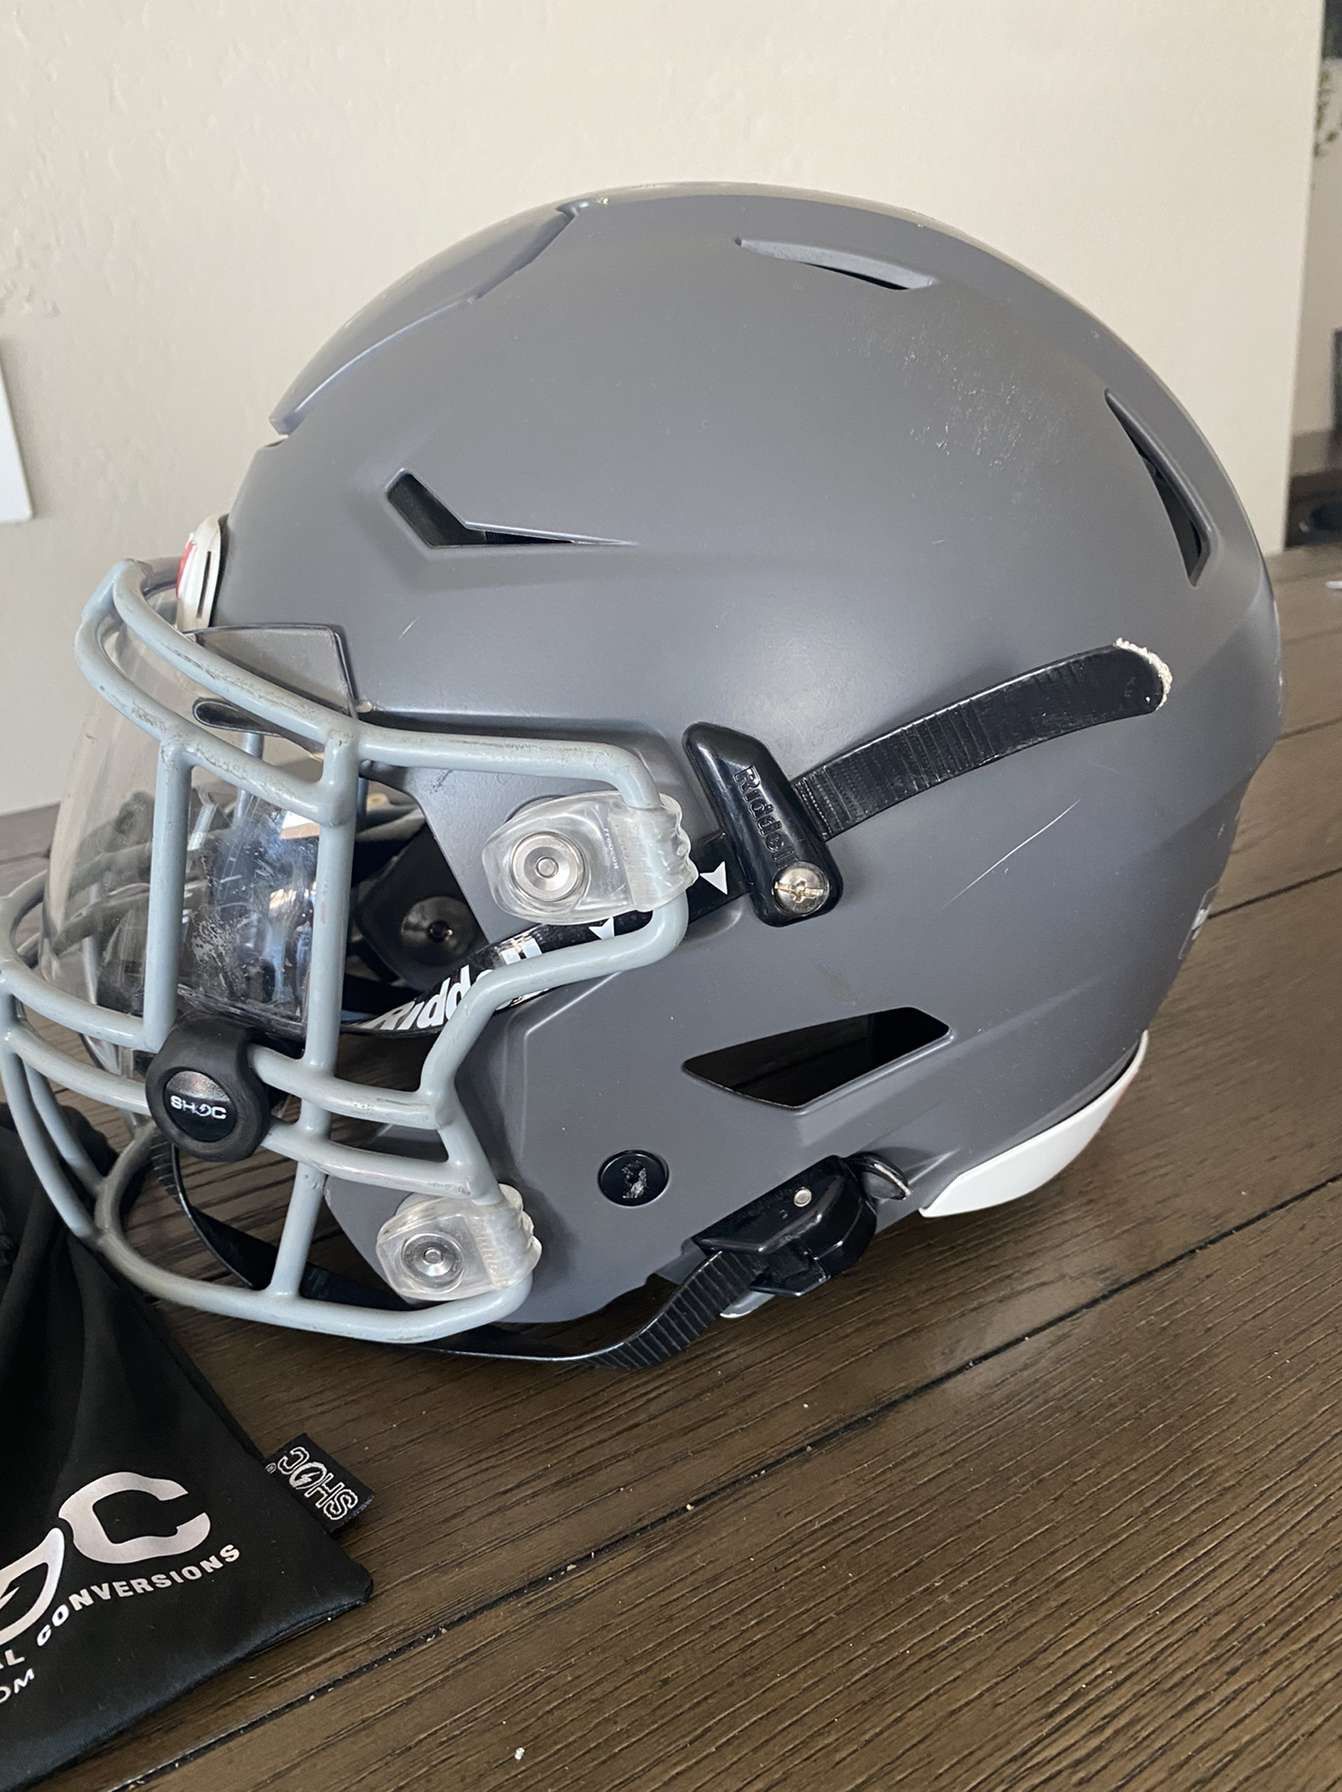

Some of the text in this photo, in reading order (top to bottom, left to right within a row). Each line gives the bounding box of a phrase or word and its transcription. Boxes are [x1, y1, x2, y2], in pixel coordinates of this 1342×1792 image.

[170, 1095, 227, 1120] SHOC
[277, 1446, 359, 1520] SHOC
[36, 1543, 241, 1647] CONVERSIONS
